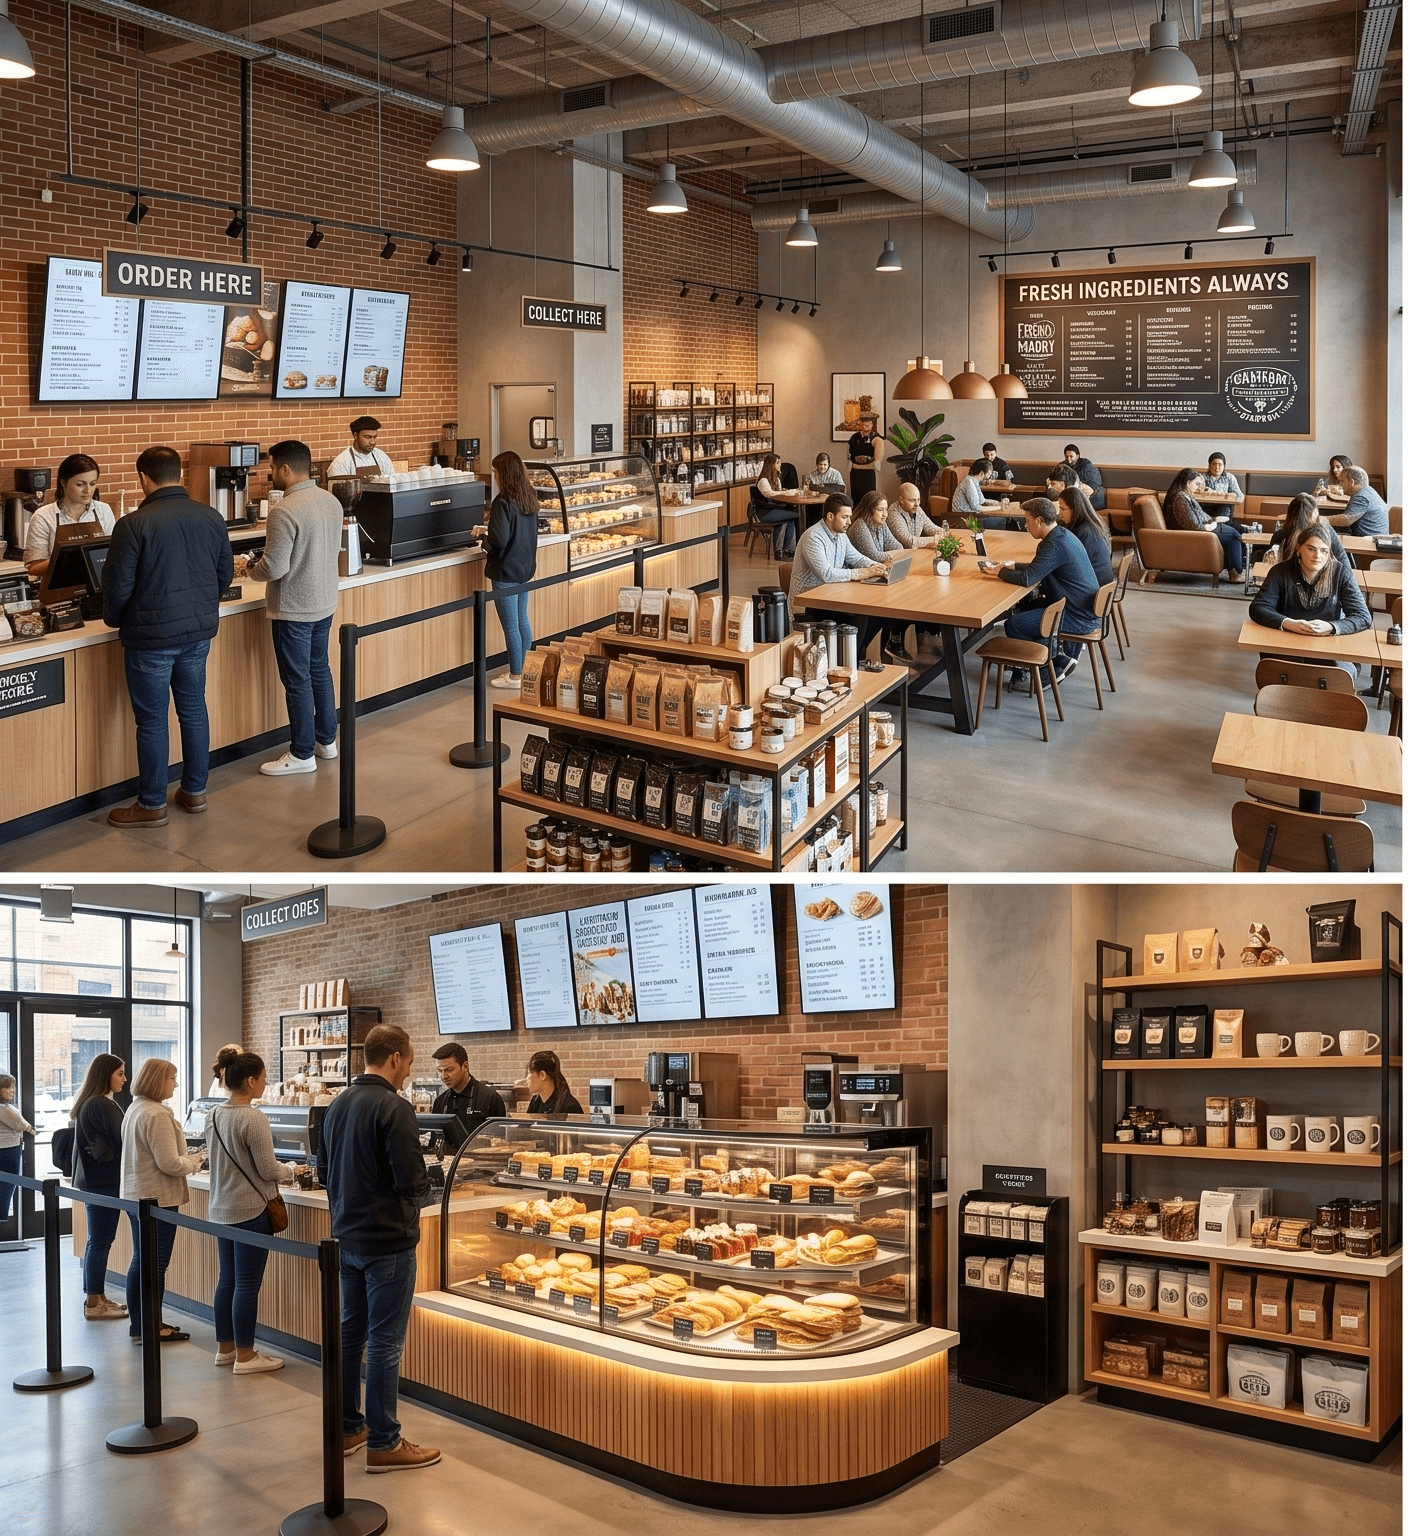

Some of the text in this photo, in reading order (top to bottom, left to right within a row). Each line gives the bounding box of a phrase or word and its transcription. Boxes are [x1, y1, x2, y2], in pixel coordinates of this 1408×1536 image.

[117, 262, 193, 290] ORDER
[200, 271, 253, 296] HERE
[1019, 271, 1290, 302] FRESH INGREDIENTS ALWAYS
[528, 305, 602, 325] COLLECT HERE
[246, 905, 290, 930] COLLECT
